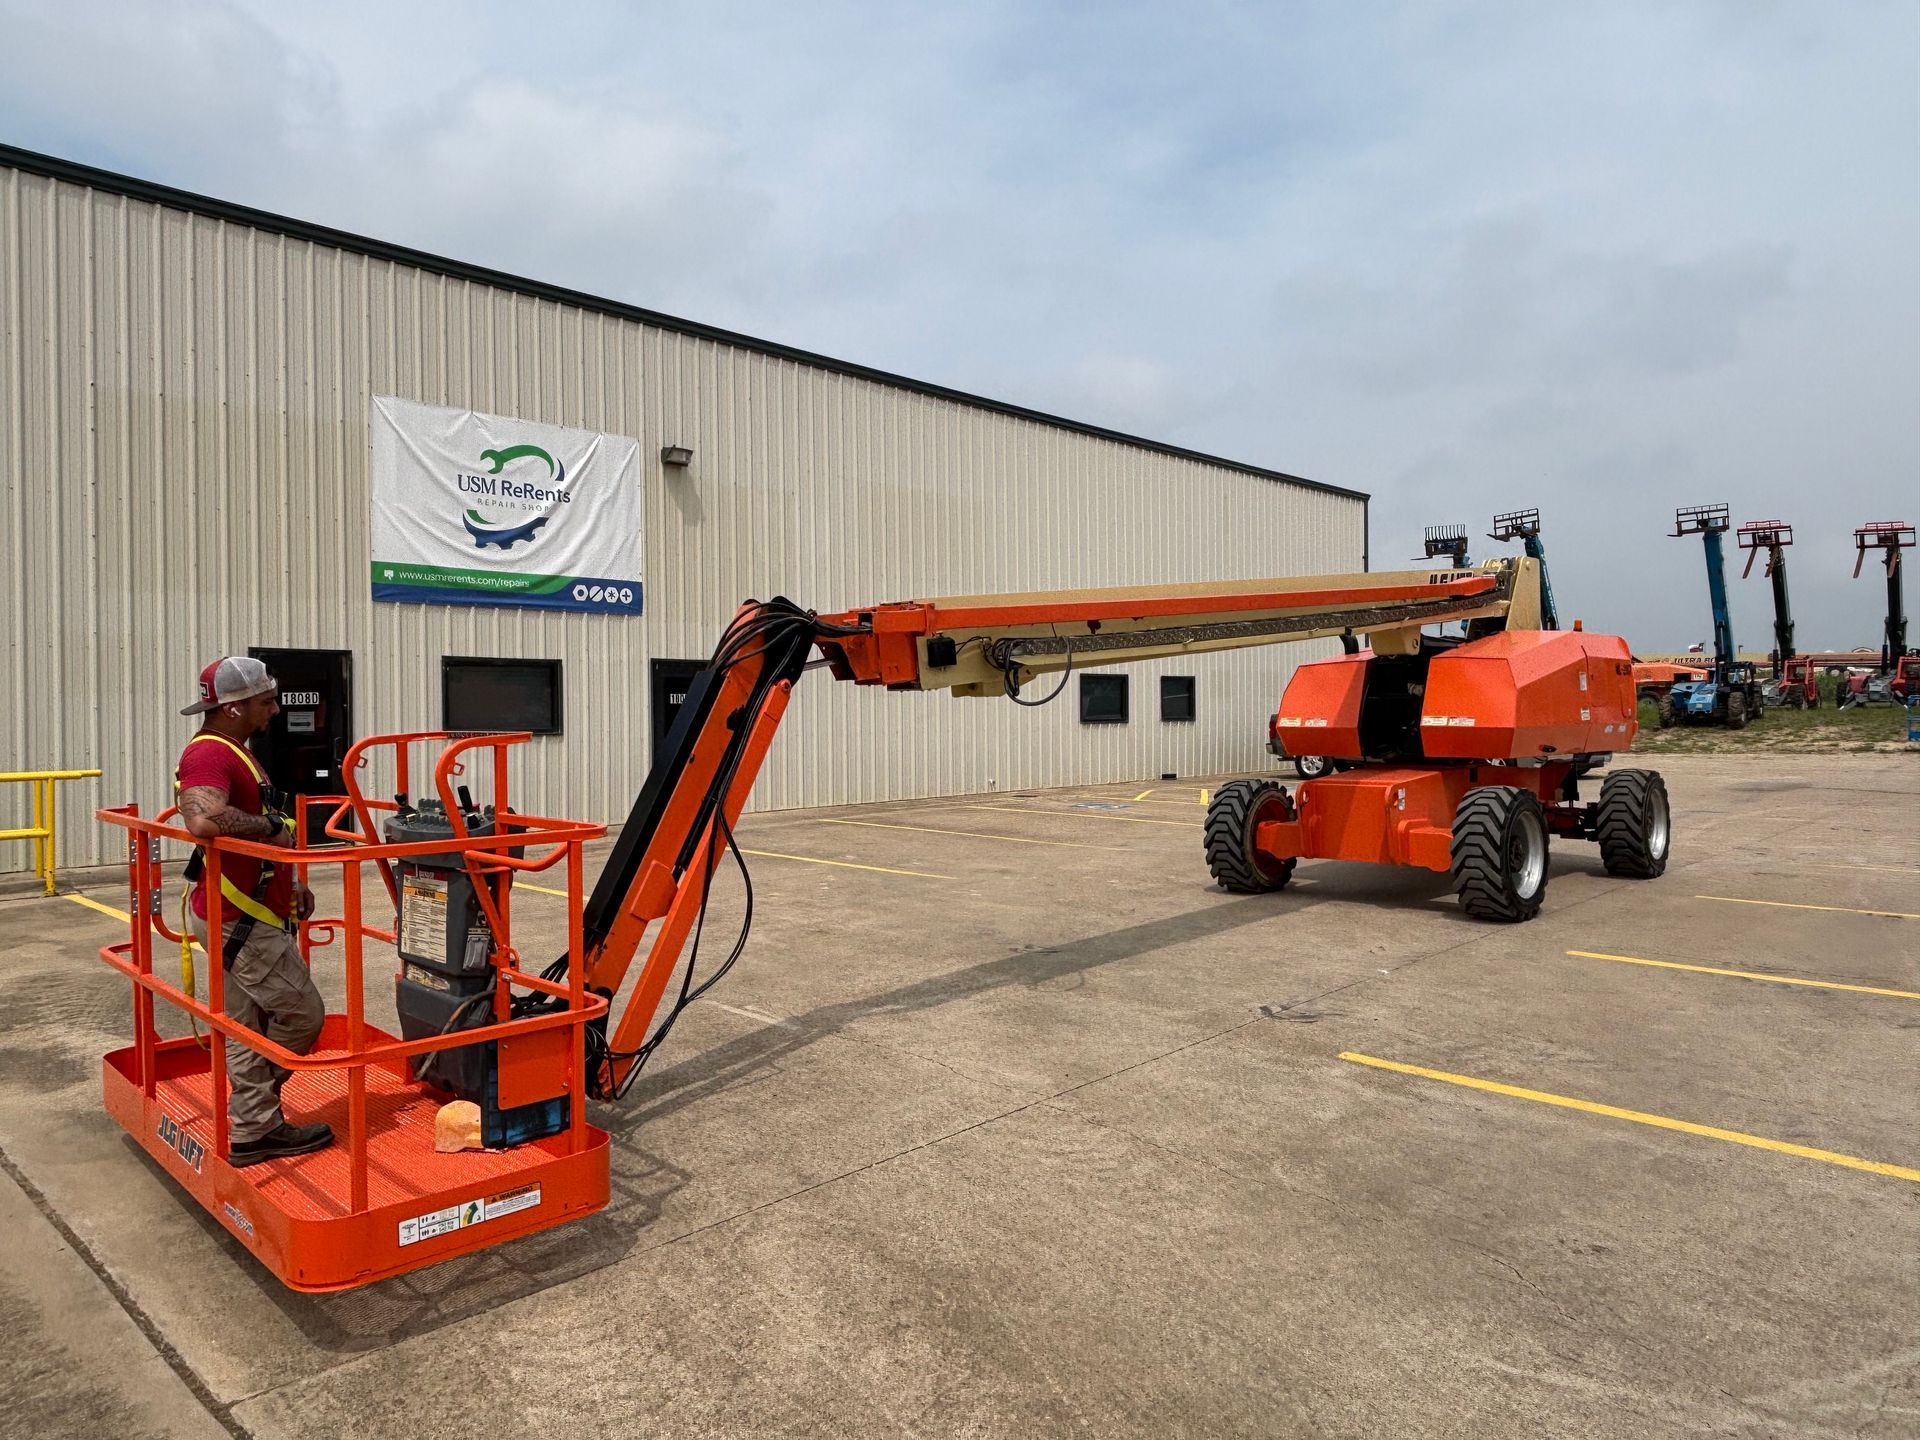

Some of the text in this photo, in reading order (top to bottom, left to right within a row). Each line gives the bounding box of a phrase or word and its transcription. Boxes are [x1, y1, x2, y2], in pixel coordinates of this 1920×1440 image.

[457, 474, 571, 503] USM ReRents
[477, 498, 516, 509] REPAIR
[178, 1128, 204, 1174] LIFT
